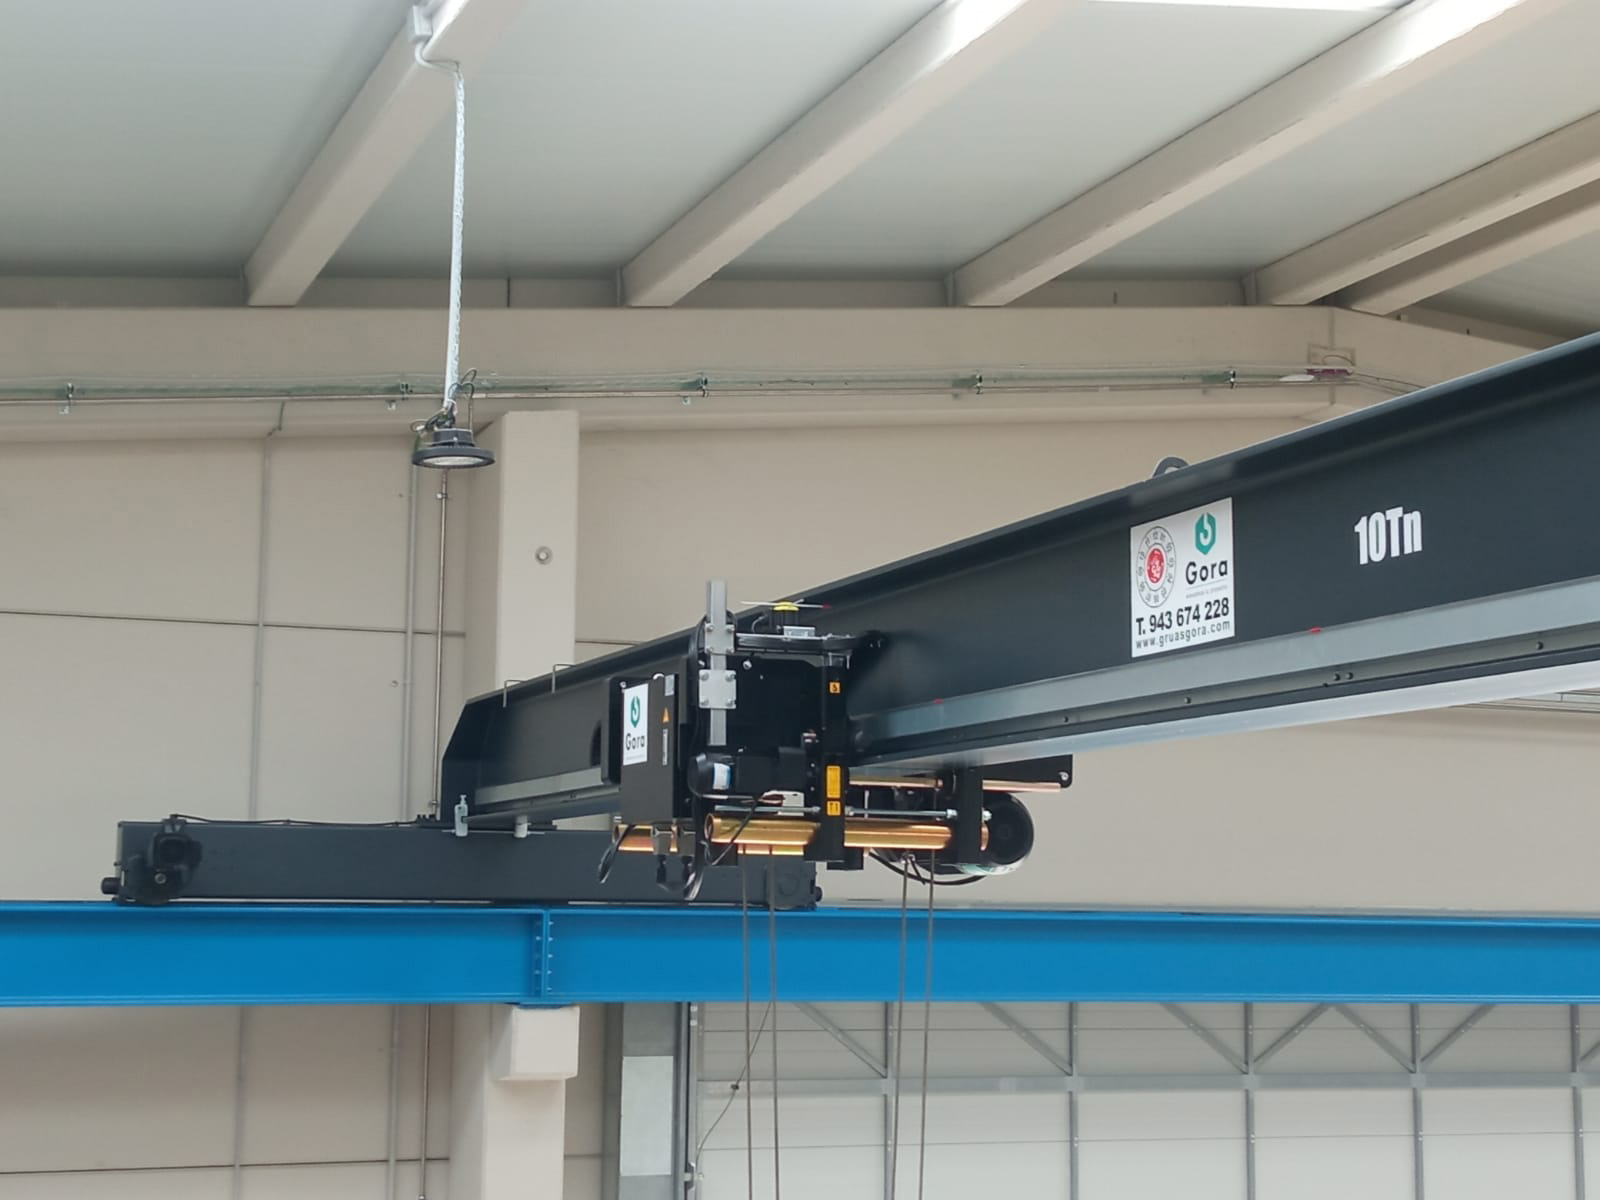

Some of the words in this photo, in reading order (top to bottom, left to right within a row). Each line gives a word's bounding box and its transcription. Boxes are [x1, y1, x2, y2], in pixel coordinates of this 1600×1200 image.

[1354, 506, 1422, 565] 10Tn
[1186, 560, 1228, 584] Gora
[1136, 617, 1146, 635] T.
[1149, 611, 1172, 633] 943
[1176, 604, 1201, 627] 674
[1204, 597, 1230, 620] 228
[1136, 620, 1230, 649] www.gruasgora.com
[625, 733, 645, 751] Gora
